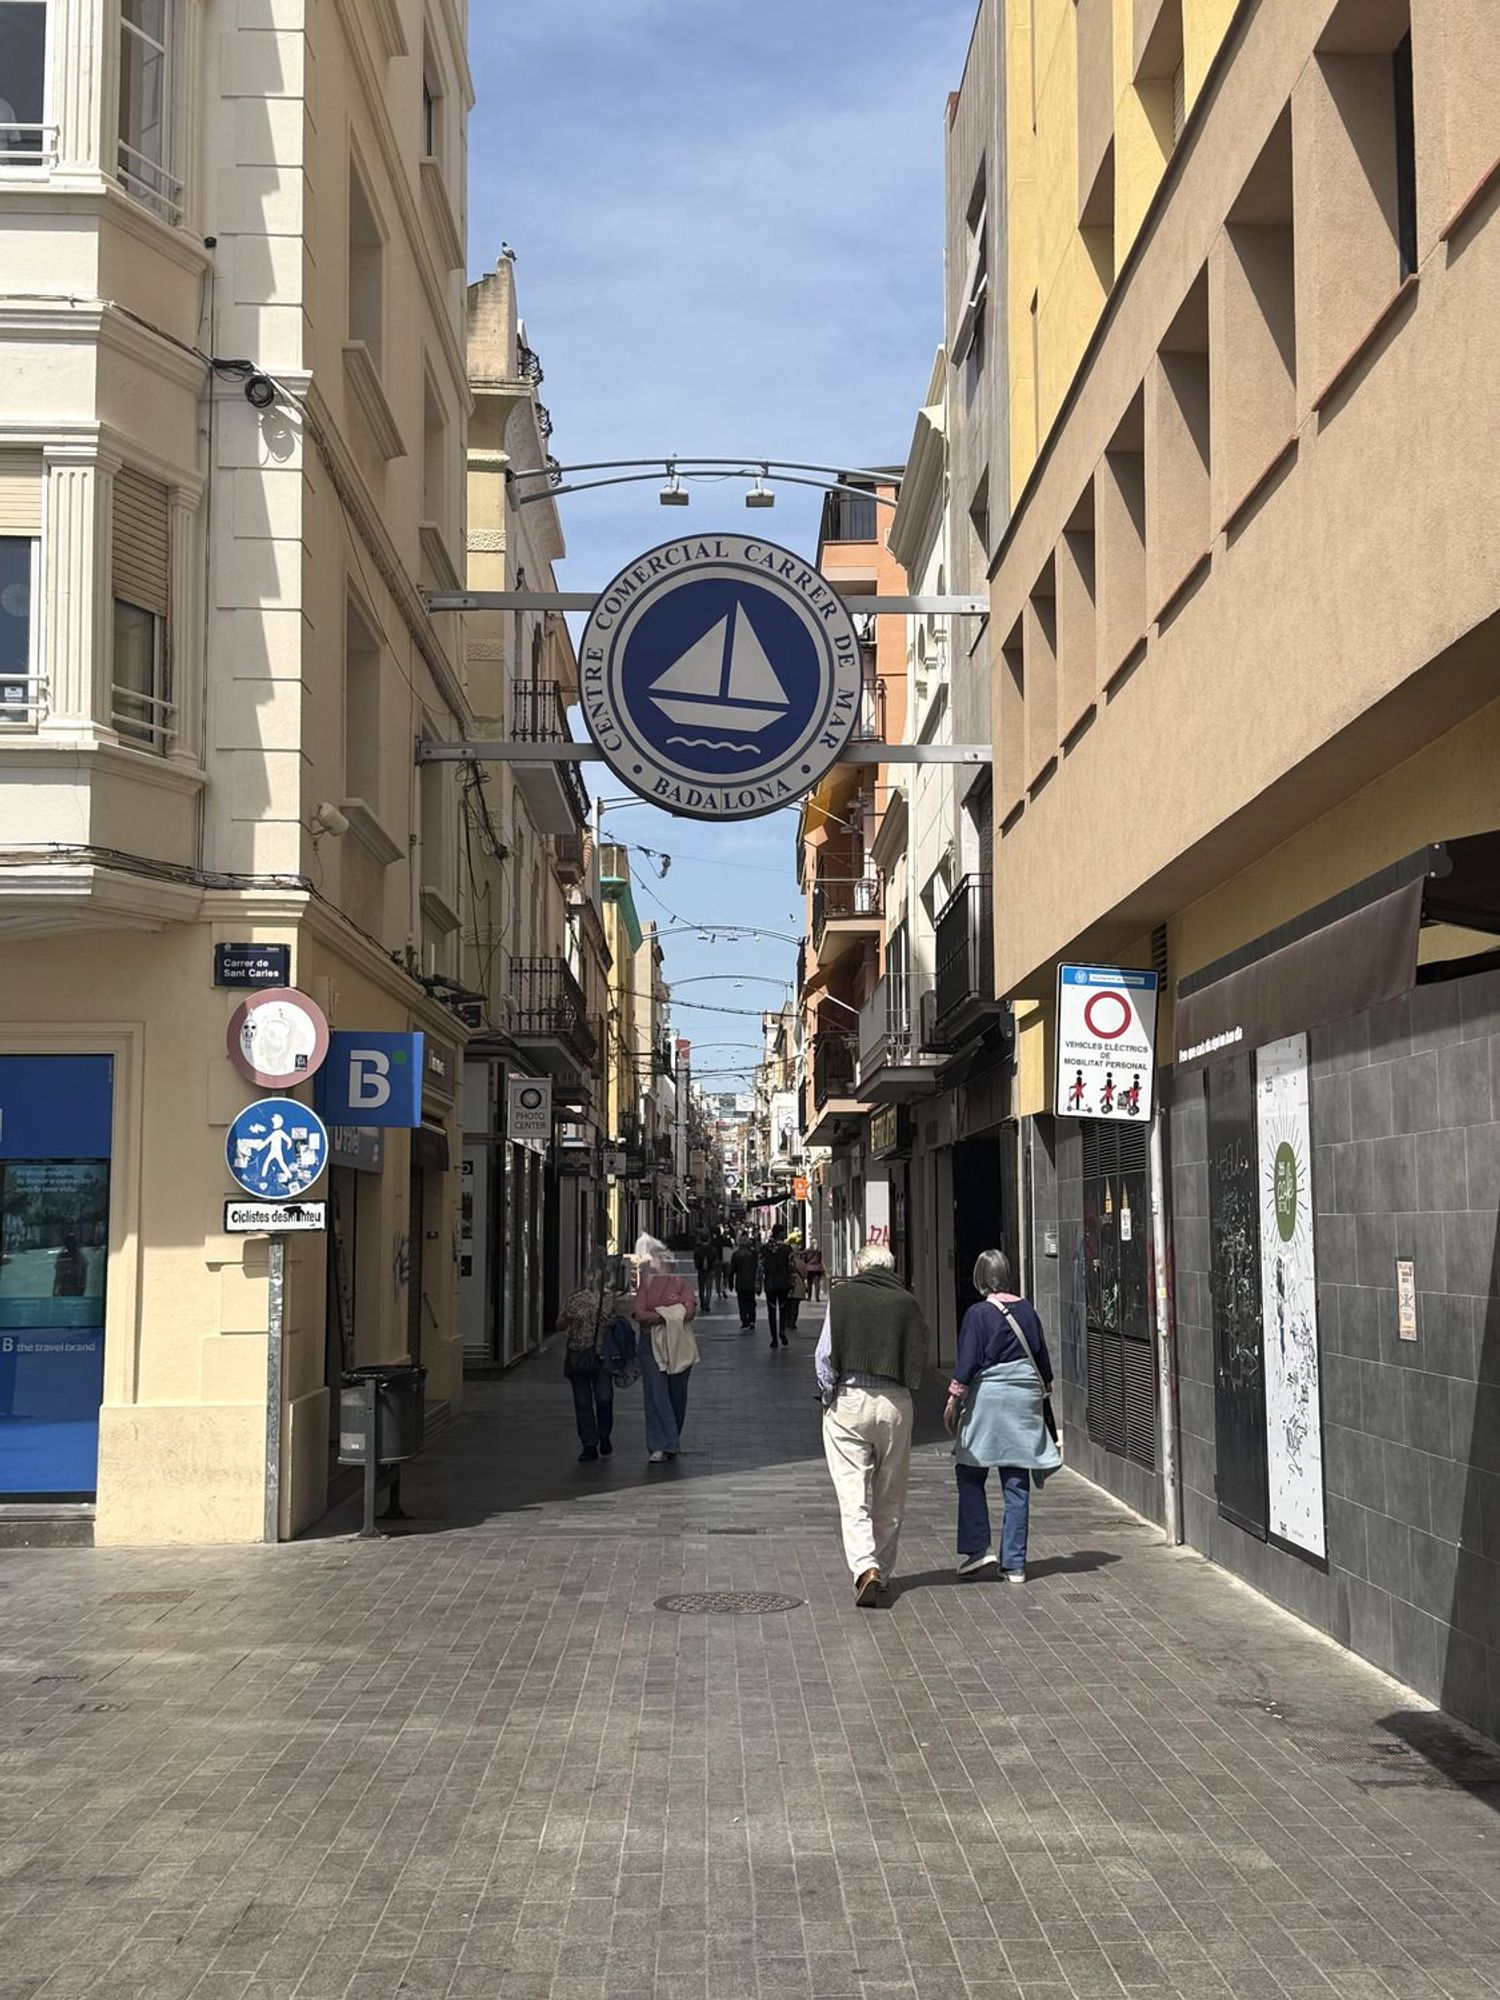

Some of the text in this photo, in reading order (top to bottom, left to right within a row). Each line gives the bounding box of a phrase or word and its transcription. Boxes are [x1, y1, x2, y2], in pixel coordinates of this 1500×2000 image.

[585, 540, 856, 751] CENTRE COMERCIAL CARRER DE MAR
[652, 776, 793, 811] BADALONA
[223, 958, 269, 967] Carrer de
[223, 968, 280, 977] Sant Carles
[1065, 1041, 1103, 1051] VEHICLES
[1100, 1052, 1111, 1060] DE
[1064, 1057, 1148, 1071] MOBILITAT PERSONAL
[348, 1049, 391, 1108] B
[515, 1111, 545, 1120] PHOTO
[513, 1121, 547, 1130] CENTER
[231, 1210, 322, 1223] Ciclistes desmnteu
[2, 1337, 96, 1352] B the travel brand
